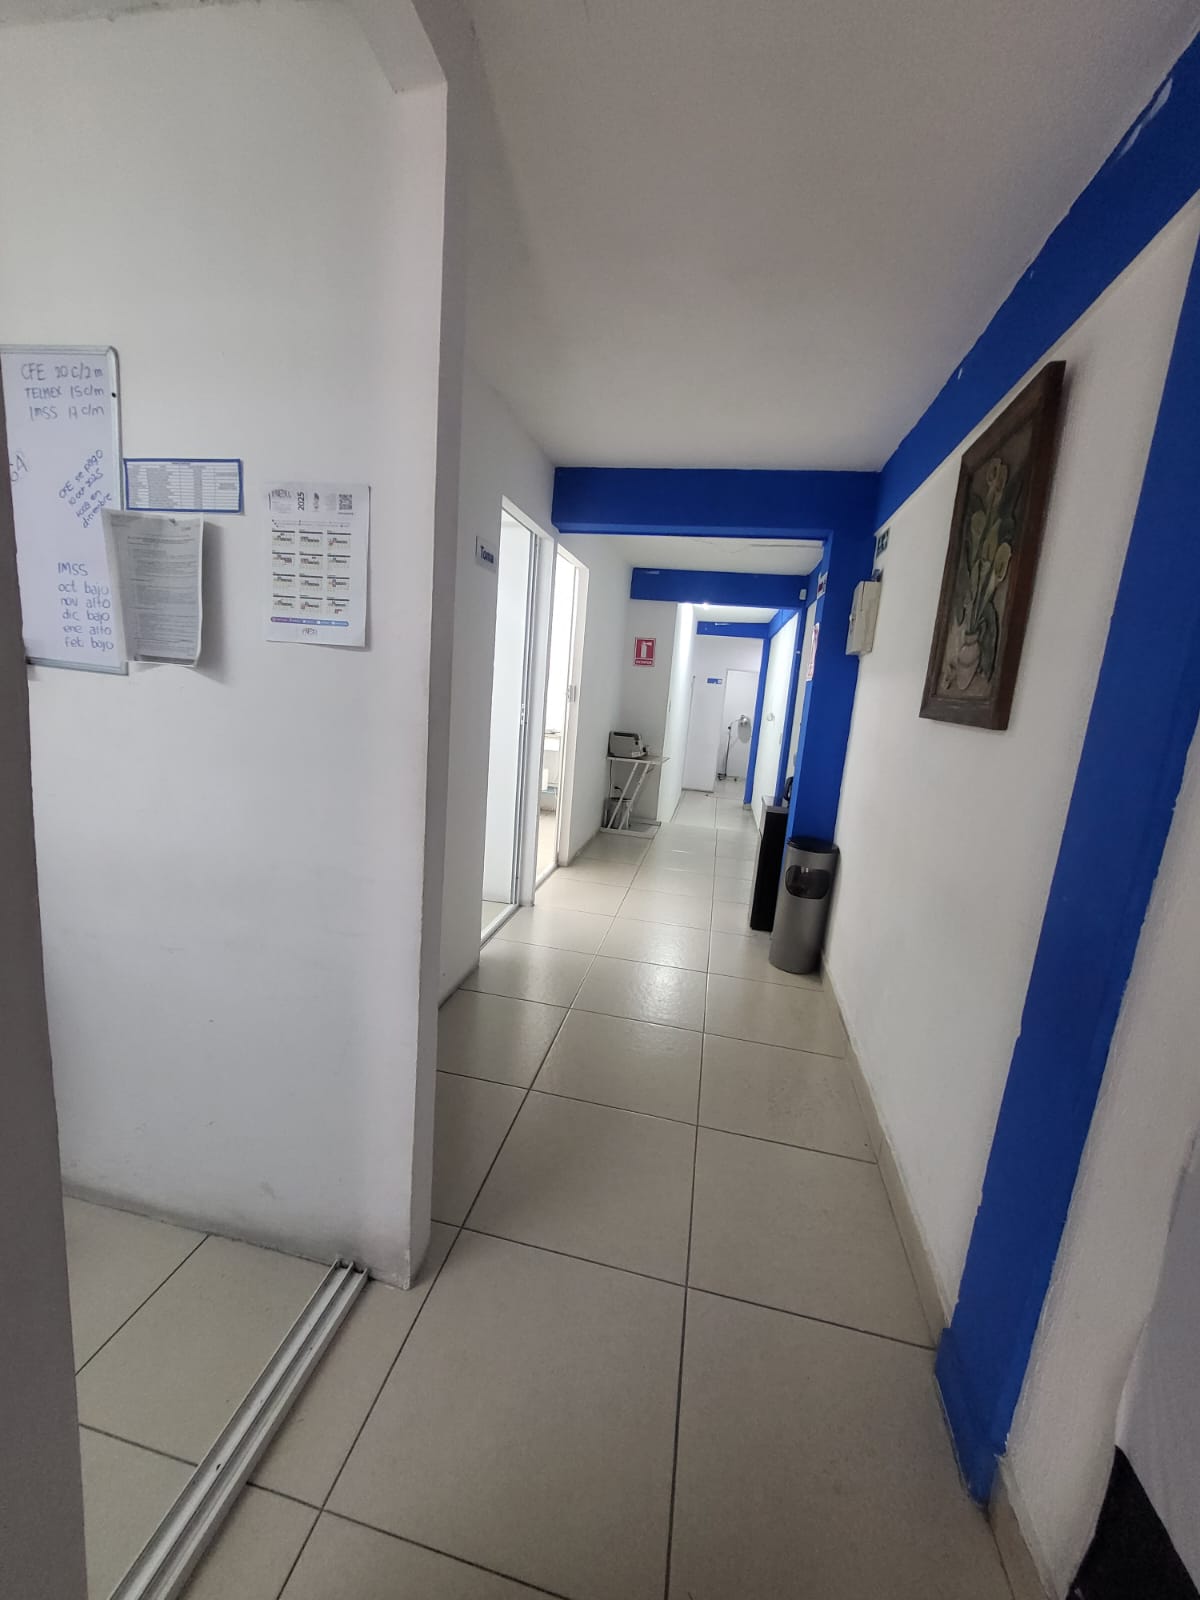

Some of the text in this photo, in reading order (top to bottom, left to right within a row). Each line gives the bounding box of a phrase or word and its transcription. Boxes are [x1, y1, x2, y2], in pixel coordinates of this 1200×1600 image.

[21, 362, 46, 381] CFE
[24, 386, 62, 399] TELMEX
[297, 491, 305, 511] 2025
[57, 562, 89, 577] IMSS
